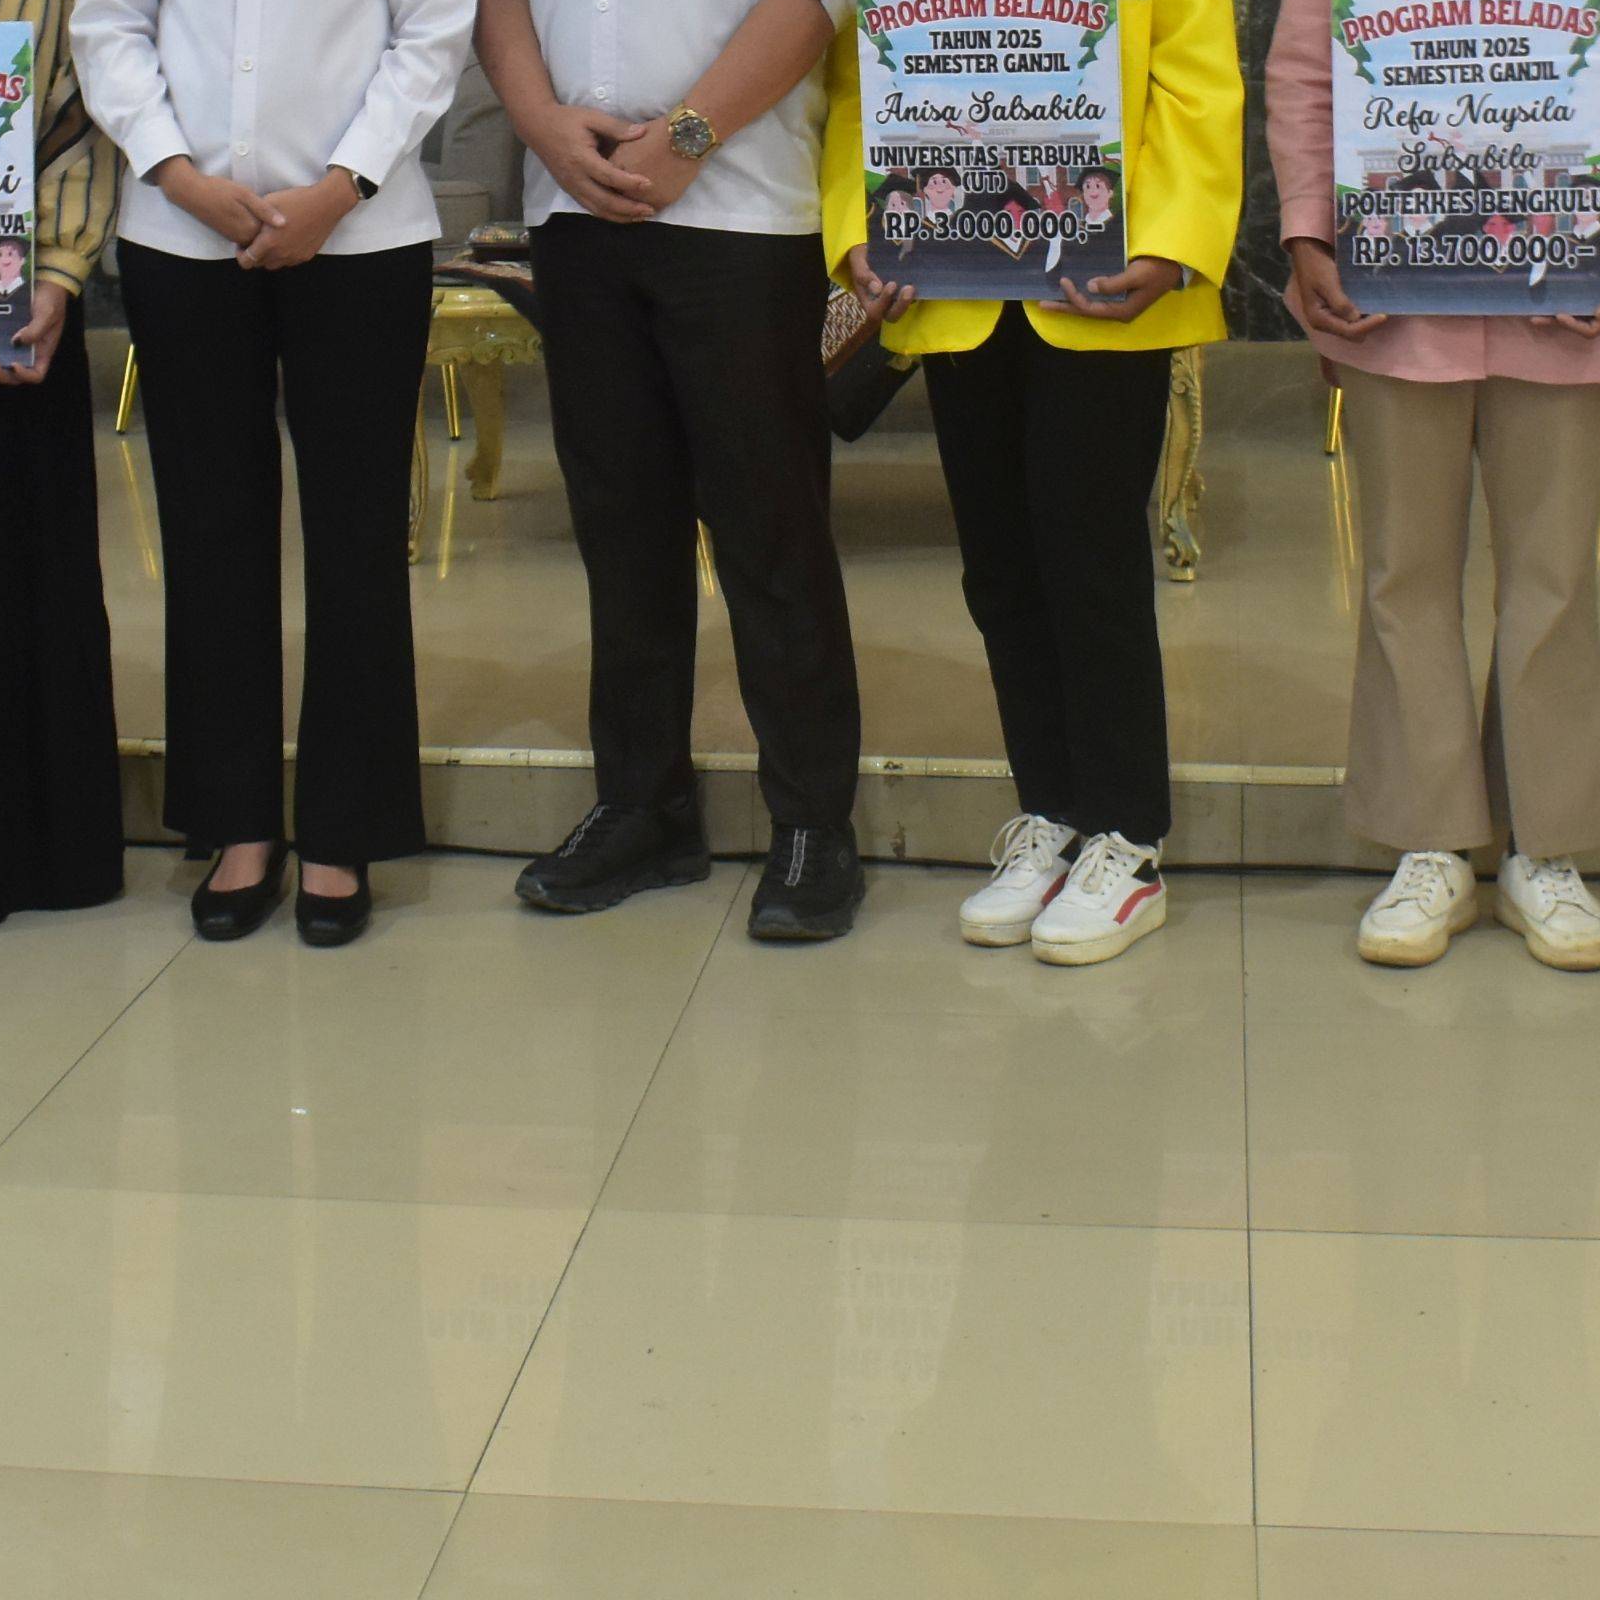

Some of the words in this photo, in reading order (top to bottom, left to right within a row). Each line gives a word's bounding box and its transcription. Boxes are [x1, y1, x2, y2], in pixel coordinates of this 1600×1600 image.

[1342, 0, 1472, 47] PROGRAM
[1479, 0, 1599, 38] BELADAS
[929, 31, 991, 50] TAHUN
[996, 29, 1042, 49] 2025
[1411, 40, 1477, 61] TAHUN
[1483, 37, 1530, 57] 2025
[904, 54, 999, 75] SEMESTER
[1003, 53, 1070, 72] GANJIL
[1384, 64, 1485, 87] SEMESTER
[1491, 61, 1560, 83] GANJIL
[876, 92, 962, 124] Anisa
[968, 91, 1106, 123] Salsabila
[1364, 97, 1439, 134] Refa
[1447, 93, 1574, 133] Naysila
[870, 145, 999, 167] UNIVERSITAS
[1004, 144, 1101, 166] TERBUKA
[1398, 142, 1542, 175] Salsabila
[962, 171, 1007, 193] (UT)
[1345, 190, 1475, 216] POLTEKKES
[885, 212, 928, 240] RP.
[934, 211, 1105, 244] 3.000.000,-
[1354, 236, 1399, 265] RP.
